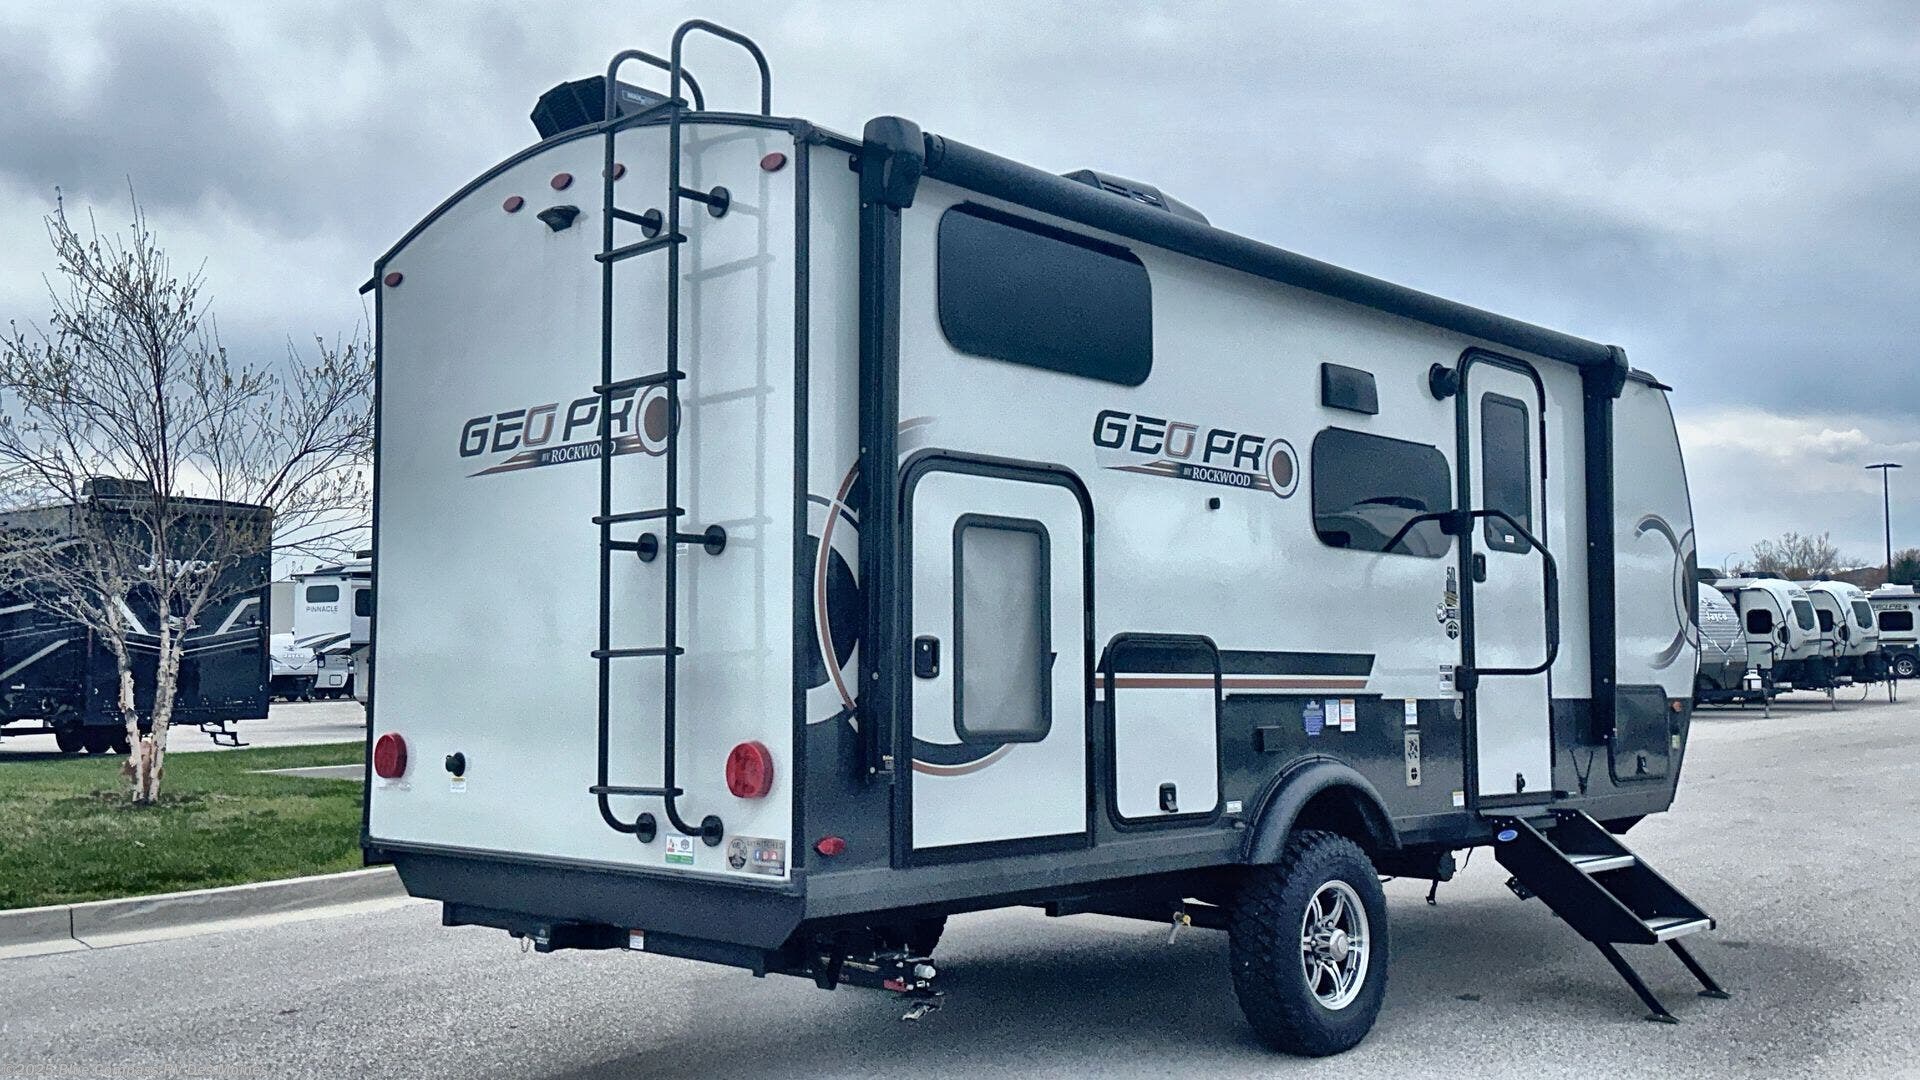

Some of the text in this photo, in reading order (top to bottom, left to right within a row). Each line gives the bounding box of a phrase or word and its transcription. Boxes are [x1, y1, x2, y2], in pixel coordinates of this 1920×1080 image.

[459, 384, 682, 458] GEO PRO
[551, 441, 617, 463] ROCKWOD
[1093, 409, 1300, 499] GEO PRO
[1191, 466, 1251, 487] ROCKWOOD
[306, 605, 339, 613] PINNACLE
